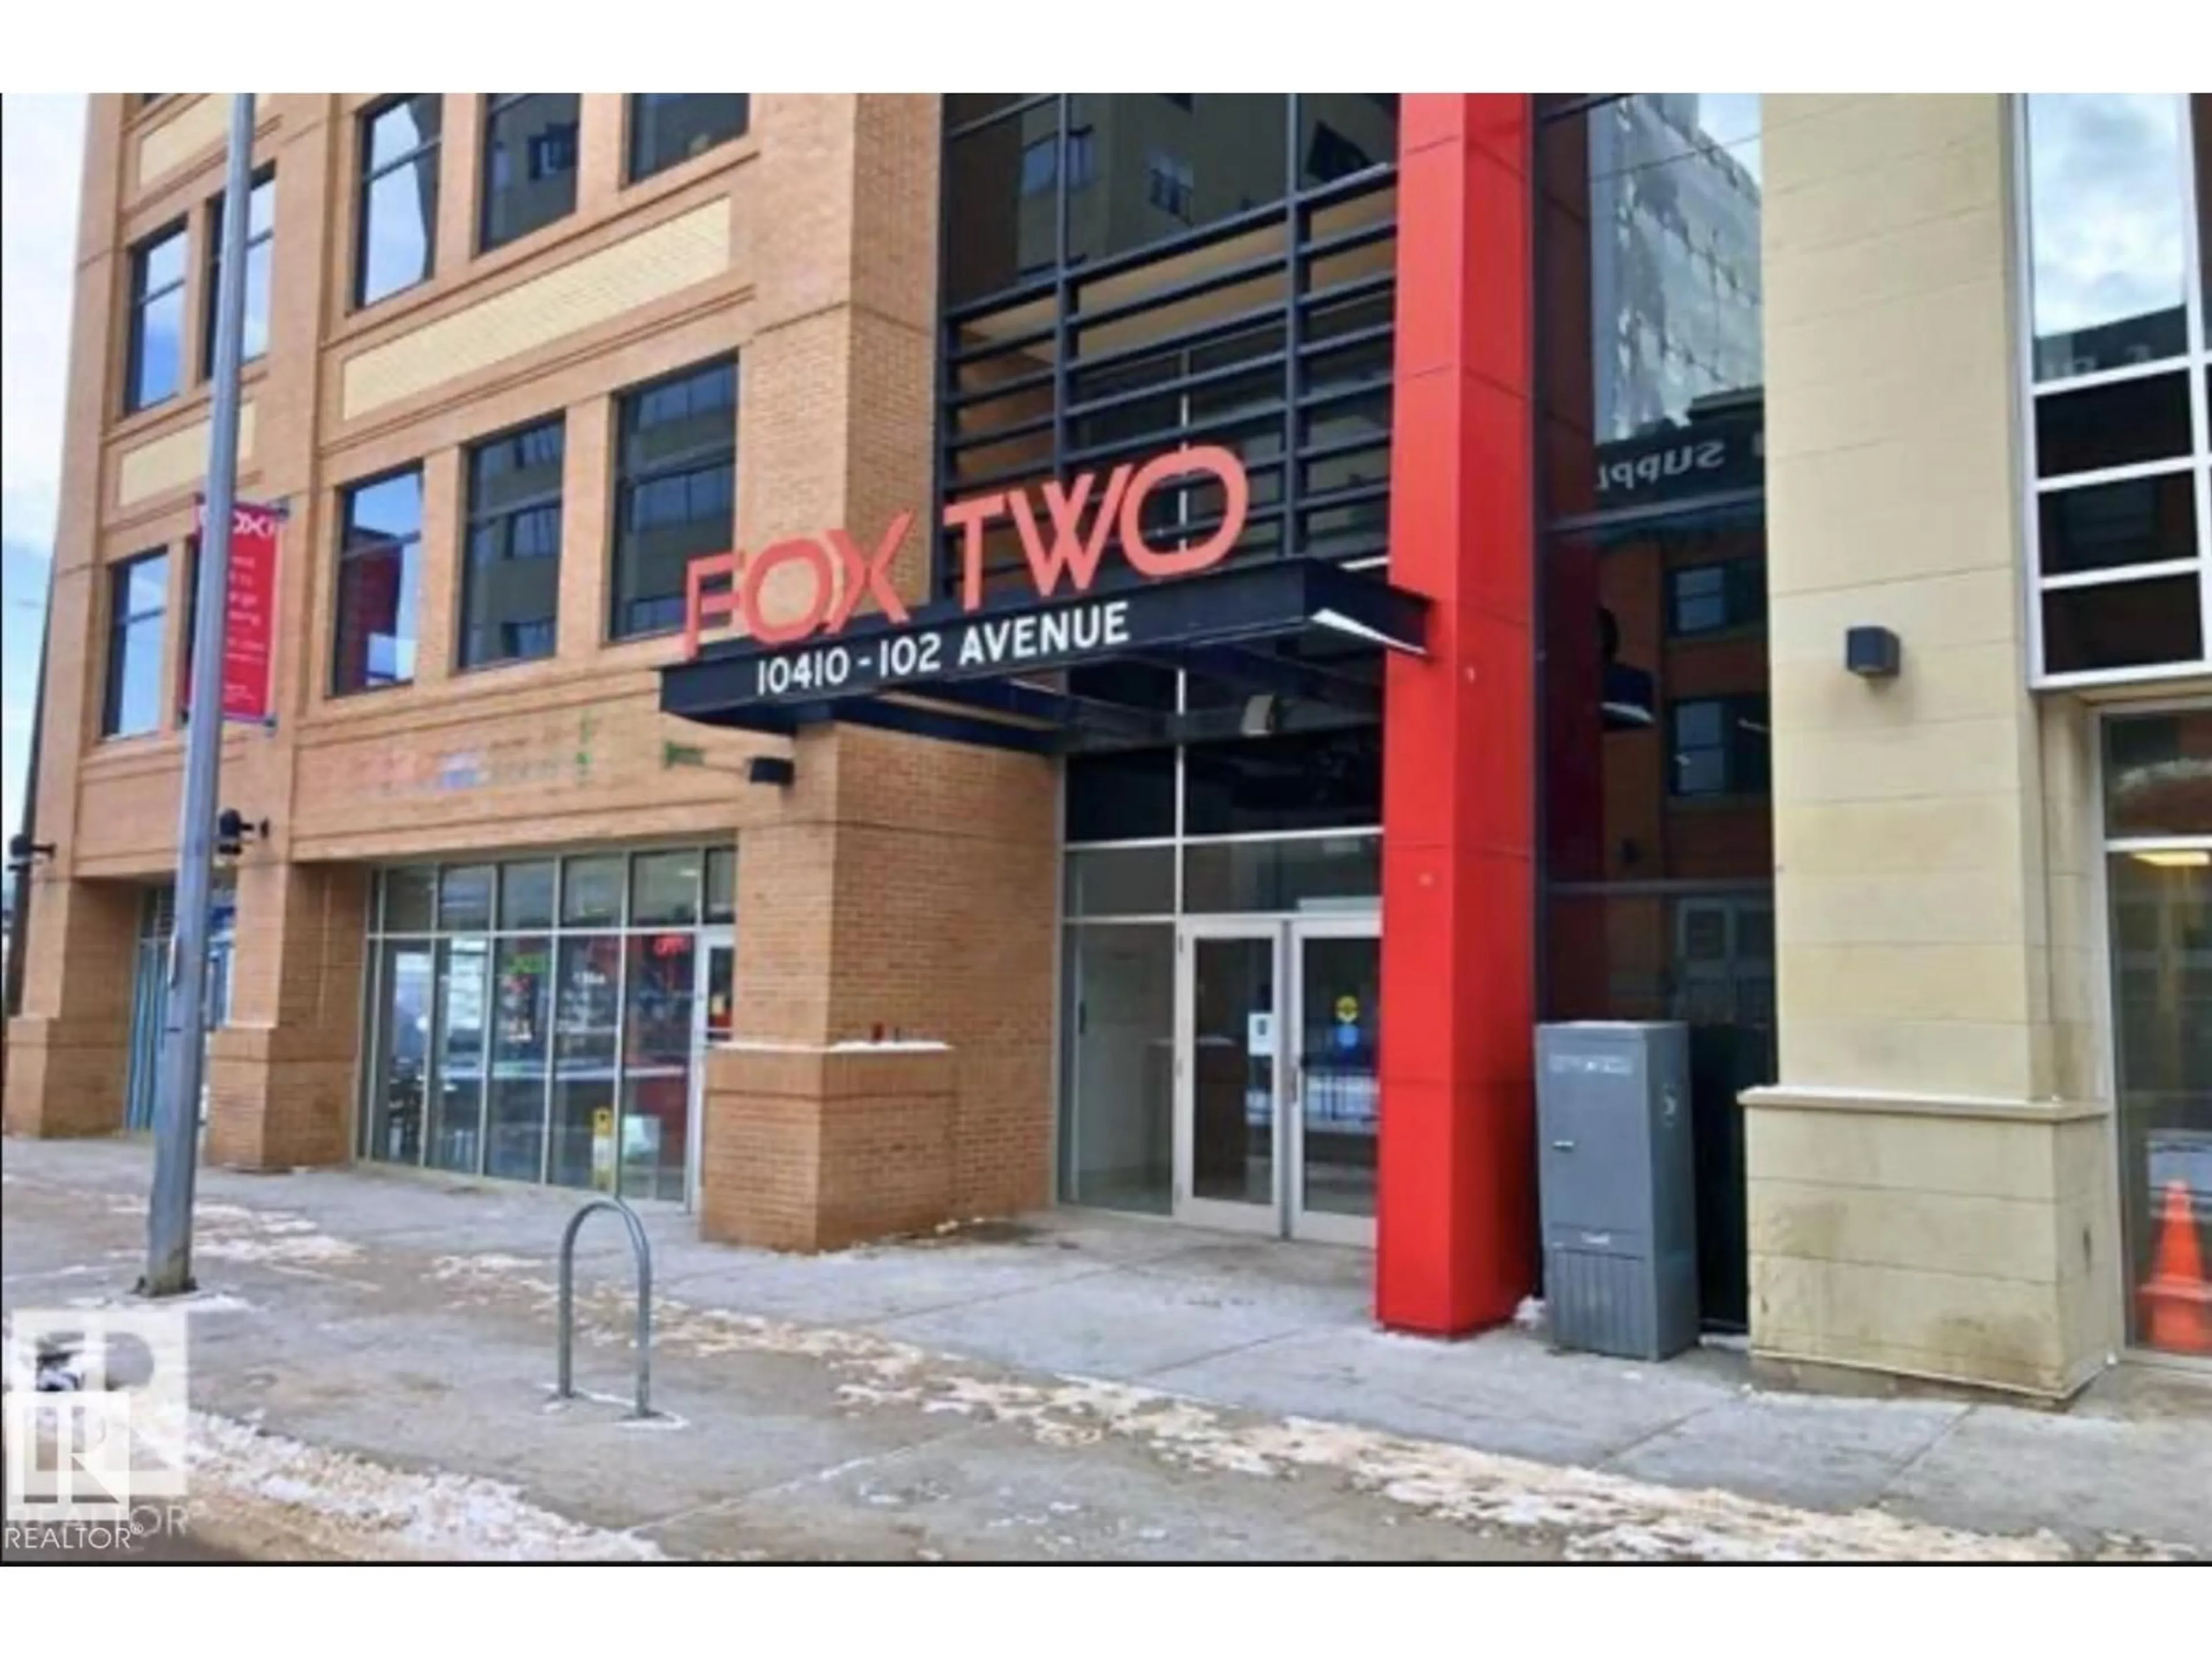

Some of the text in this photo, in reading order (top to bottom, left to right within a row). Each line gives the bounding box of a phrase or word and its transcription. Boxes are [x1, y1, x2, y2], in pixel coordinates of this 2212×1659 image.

[683, 445, 1248, 657] FOX TWO
[960, 602, 1128, 665] AVENUE
